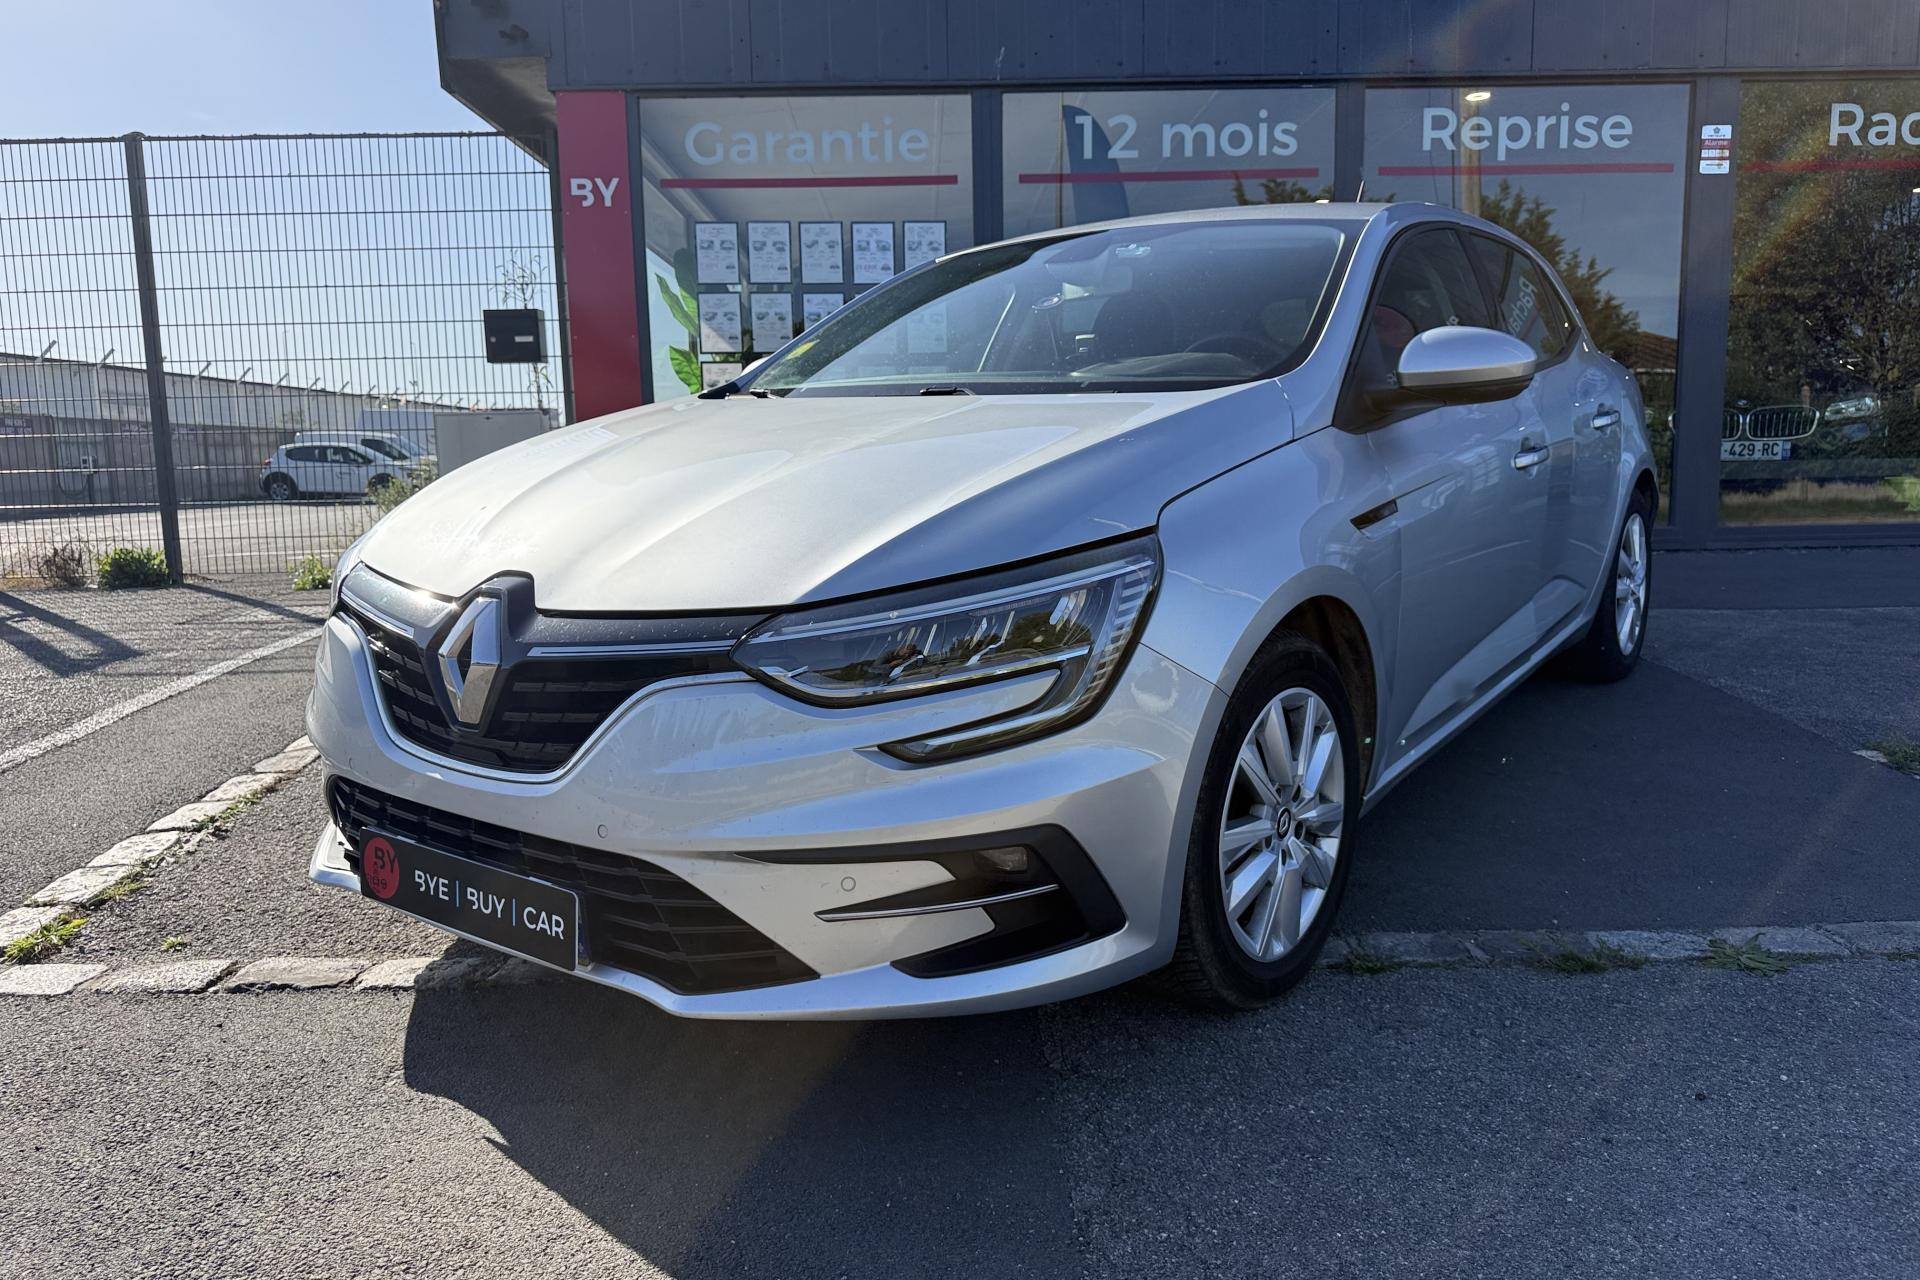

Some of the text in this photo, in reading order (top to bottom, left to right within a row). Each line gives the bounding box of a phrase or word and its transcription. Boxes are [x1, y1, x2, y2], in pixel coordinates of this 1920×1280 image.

[684, 115, 930, 166] Garantie
[1075, 109, 1298, 159] 12 mois
[1422, 102, 1633, 161] Reprise
[569, 177, 619, 207] BY
[374, 846, 399, 873] BY
[414, 869, 449, 901] BYE
[467, 887, 505, 919] BUY
[523, 906, 565, 940] CAR
